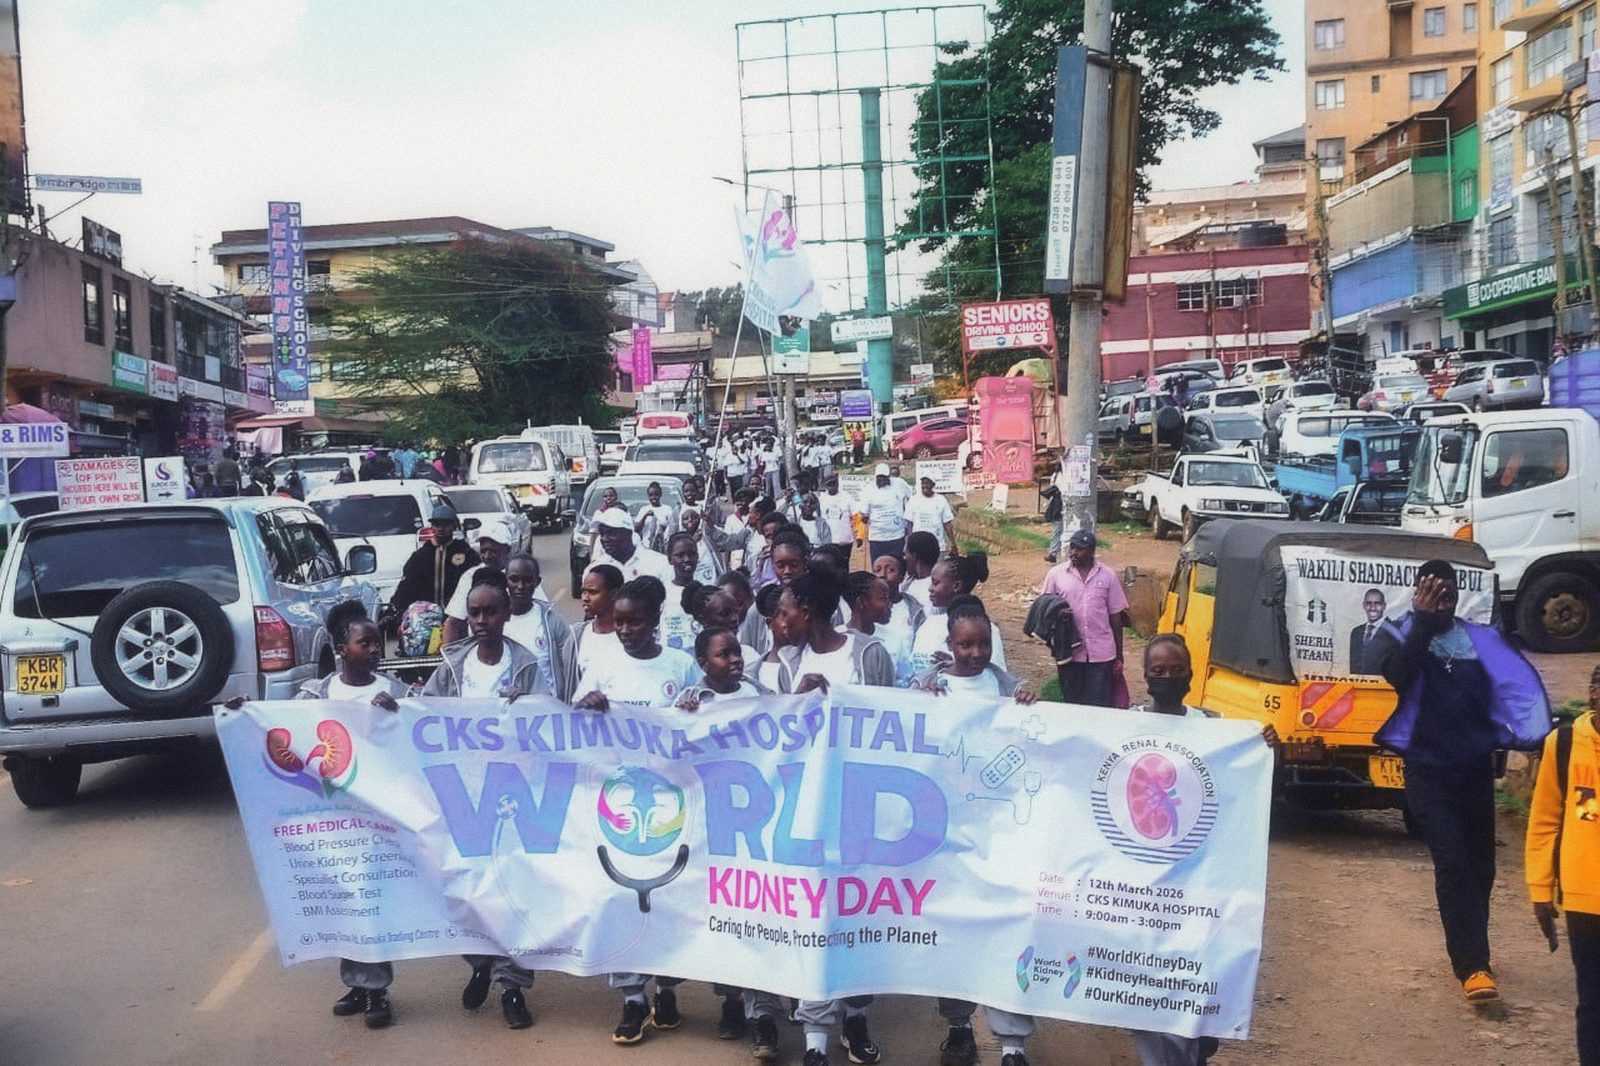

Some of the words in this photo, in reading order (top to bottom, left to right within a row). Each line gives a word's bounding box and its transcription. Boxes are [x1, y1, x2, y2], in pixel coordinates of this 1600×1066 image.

[289, 204, 304, 291] DRIVING
[1480, 269, 1537, 301] CO-OPERATIVE
[964, 302, 1050, 326] SENIORS
[293, 296, 307, 369] SCHOOL
[965, 325, 1005, 337] DRIVING
[1009, 321, 1049, 333] SCHOOL
[2, 429, 13, 443] &
[19, 425, 65, 443] RIMS
[73, 461, 124, 471] DAMAGES
[75, 472, 91, 482] (OF
[94, 483, 111, 492] HERE
[113, 483, 128, 491] WILL
[130, 482, 140, 491] BE
[61, 497, 71, 505] AT
[74, 495, 96, 504] YOUR
[100, 495, 120, 503] OWN
[1296, 558, 1345, 580] WAKILI
[1295, 634, 1334, 649] SHERIA
[28, 658, 58, 674] KBR
[21, 675, 58, 691] 374W
[1264, 694, 1281, 710] 65
[413, 715, 504, 753] CKS
[515, 712, 705, 759] KIMUKA
[709, 706, 940, 755] HOSPITAL
[1097, 752, 1120, 782] KENYA
[1122, 739, 1159, 753] RENAL
[1165, 742, 1215, 797] ASSOCIATION
[274, 824, 303, 837] FREE
[306, 818, 365, 834] MEDICAL
[284, 840, 315, 853] Blood
[318, 836, 368, 850] Pressure
[317, 855, 359, 867] Kidney
[341, 867, 418, 884] Consultation
[709, 866, 828, 919] KIDNEY
[837, 877, 937, 917] DAY
[1039, 872, 1064, 885] Date
[1089, 879, 1114, 891] 12th
[1117, 882, 1153, 896] March
[1156, 888, 1184, 899] 2026
[298, 890, 328, 901] Blood
[358, 888, 382, 899] Test
[1037, 887, 1071, 901] Venue
[1086, 894, 1110, 905] CKS
[1112, 897, 1160, 913] KIMUKA
[1163, 904, 1221, 919] HOSPITAL
[302, 906, 322, 917] BMI
[1036, 903, 1062, 915] Time
[1085, 910, 1129, 924] 9:00am
[1138, 915, 1182, 932] 3:00pm
[709, 915, 742, 939] Caring
[744, 920, 756, 938] for
[757, 925, 792, 947] People,
[793, 928, 855, 948] Protecting
[858, 927, 882, 943] the
[887, 926, 938, 946] Planet
[1033, 957, 1061, 967] World
[1088, 946, 1202, 975] #WorldKidneyDay
[1033, 967, 1064, 978] Kidney
[1033, 974, 1050, 984] Day
[1086, 966, 1218, 995] #KidneyHealthForAll
[1084, 987, 1221, 1016] #OurKidneyOurPlanet
